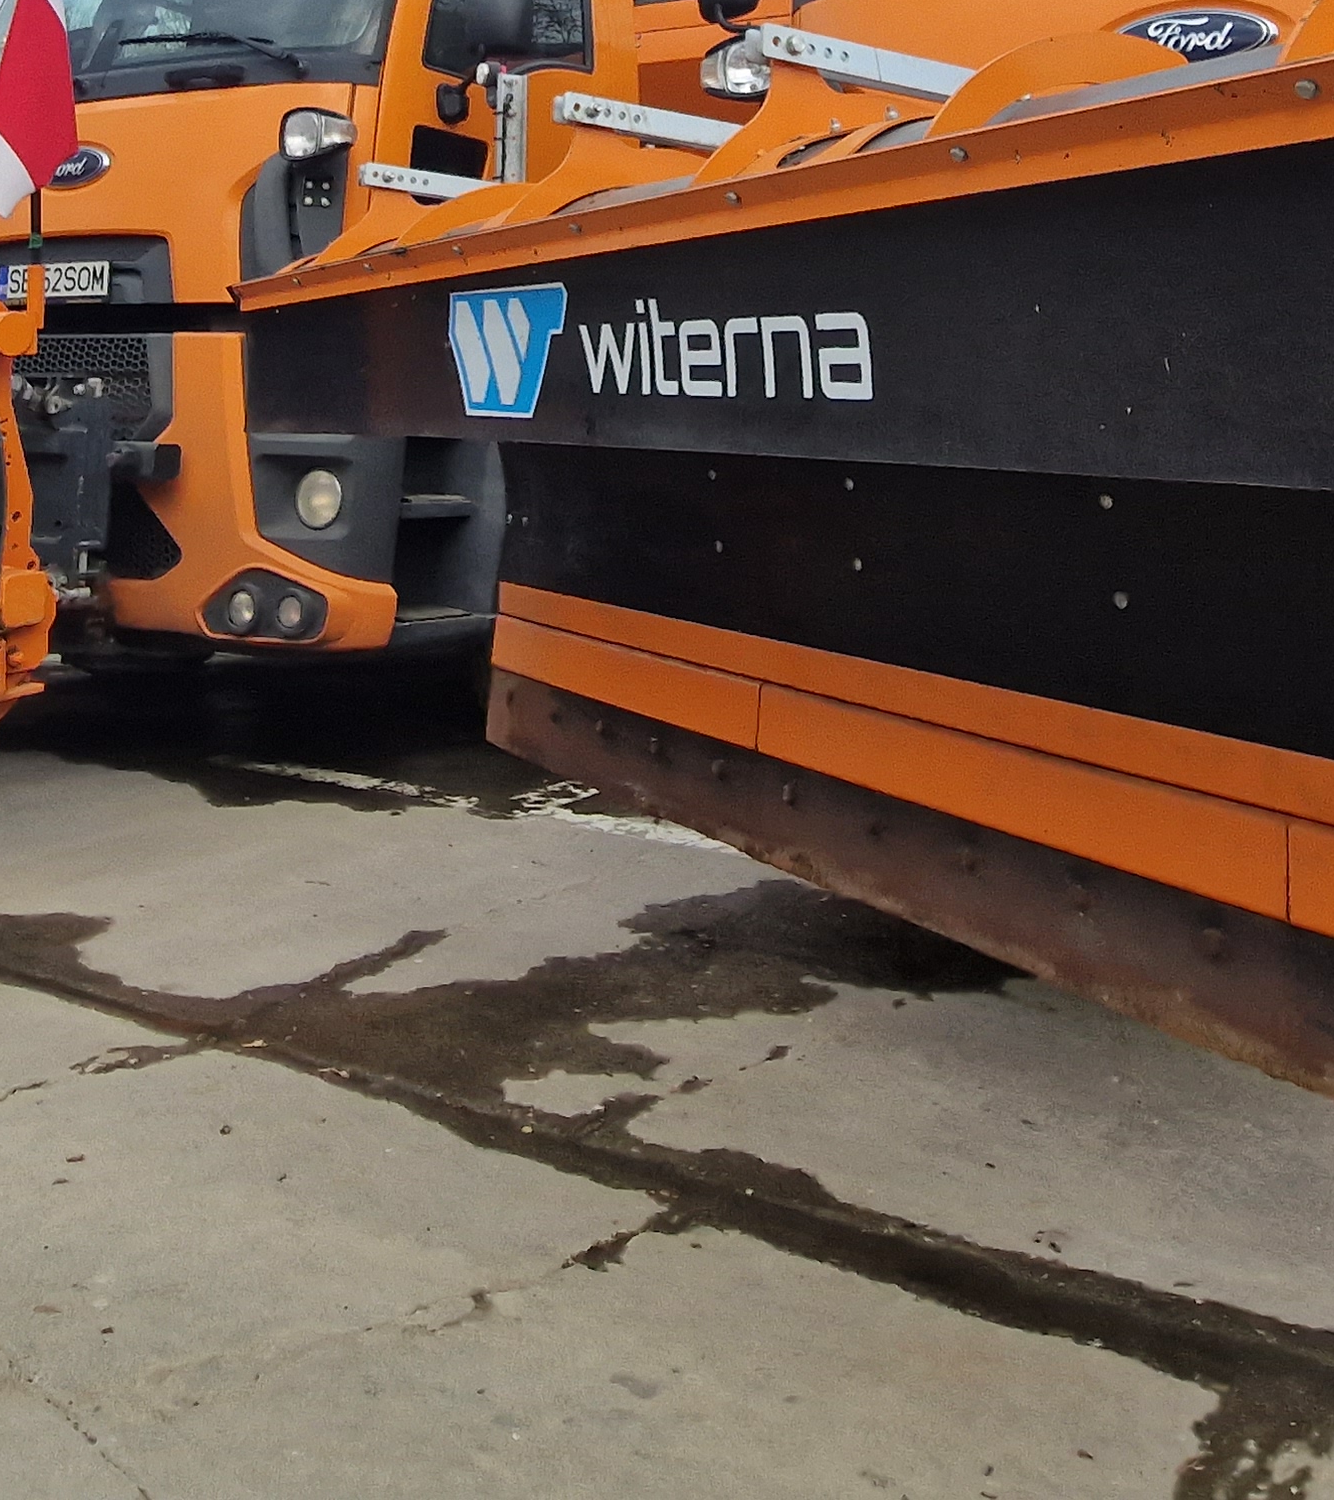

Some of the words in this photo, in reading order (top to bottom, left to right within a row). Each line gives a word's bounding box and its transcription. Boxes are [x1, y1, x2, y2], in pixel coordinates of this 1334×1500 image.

[1147, 16, 1233, 52] Ford
[55, 157, 87, 177] ord
[578, 298, 873, 401] witerna
